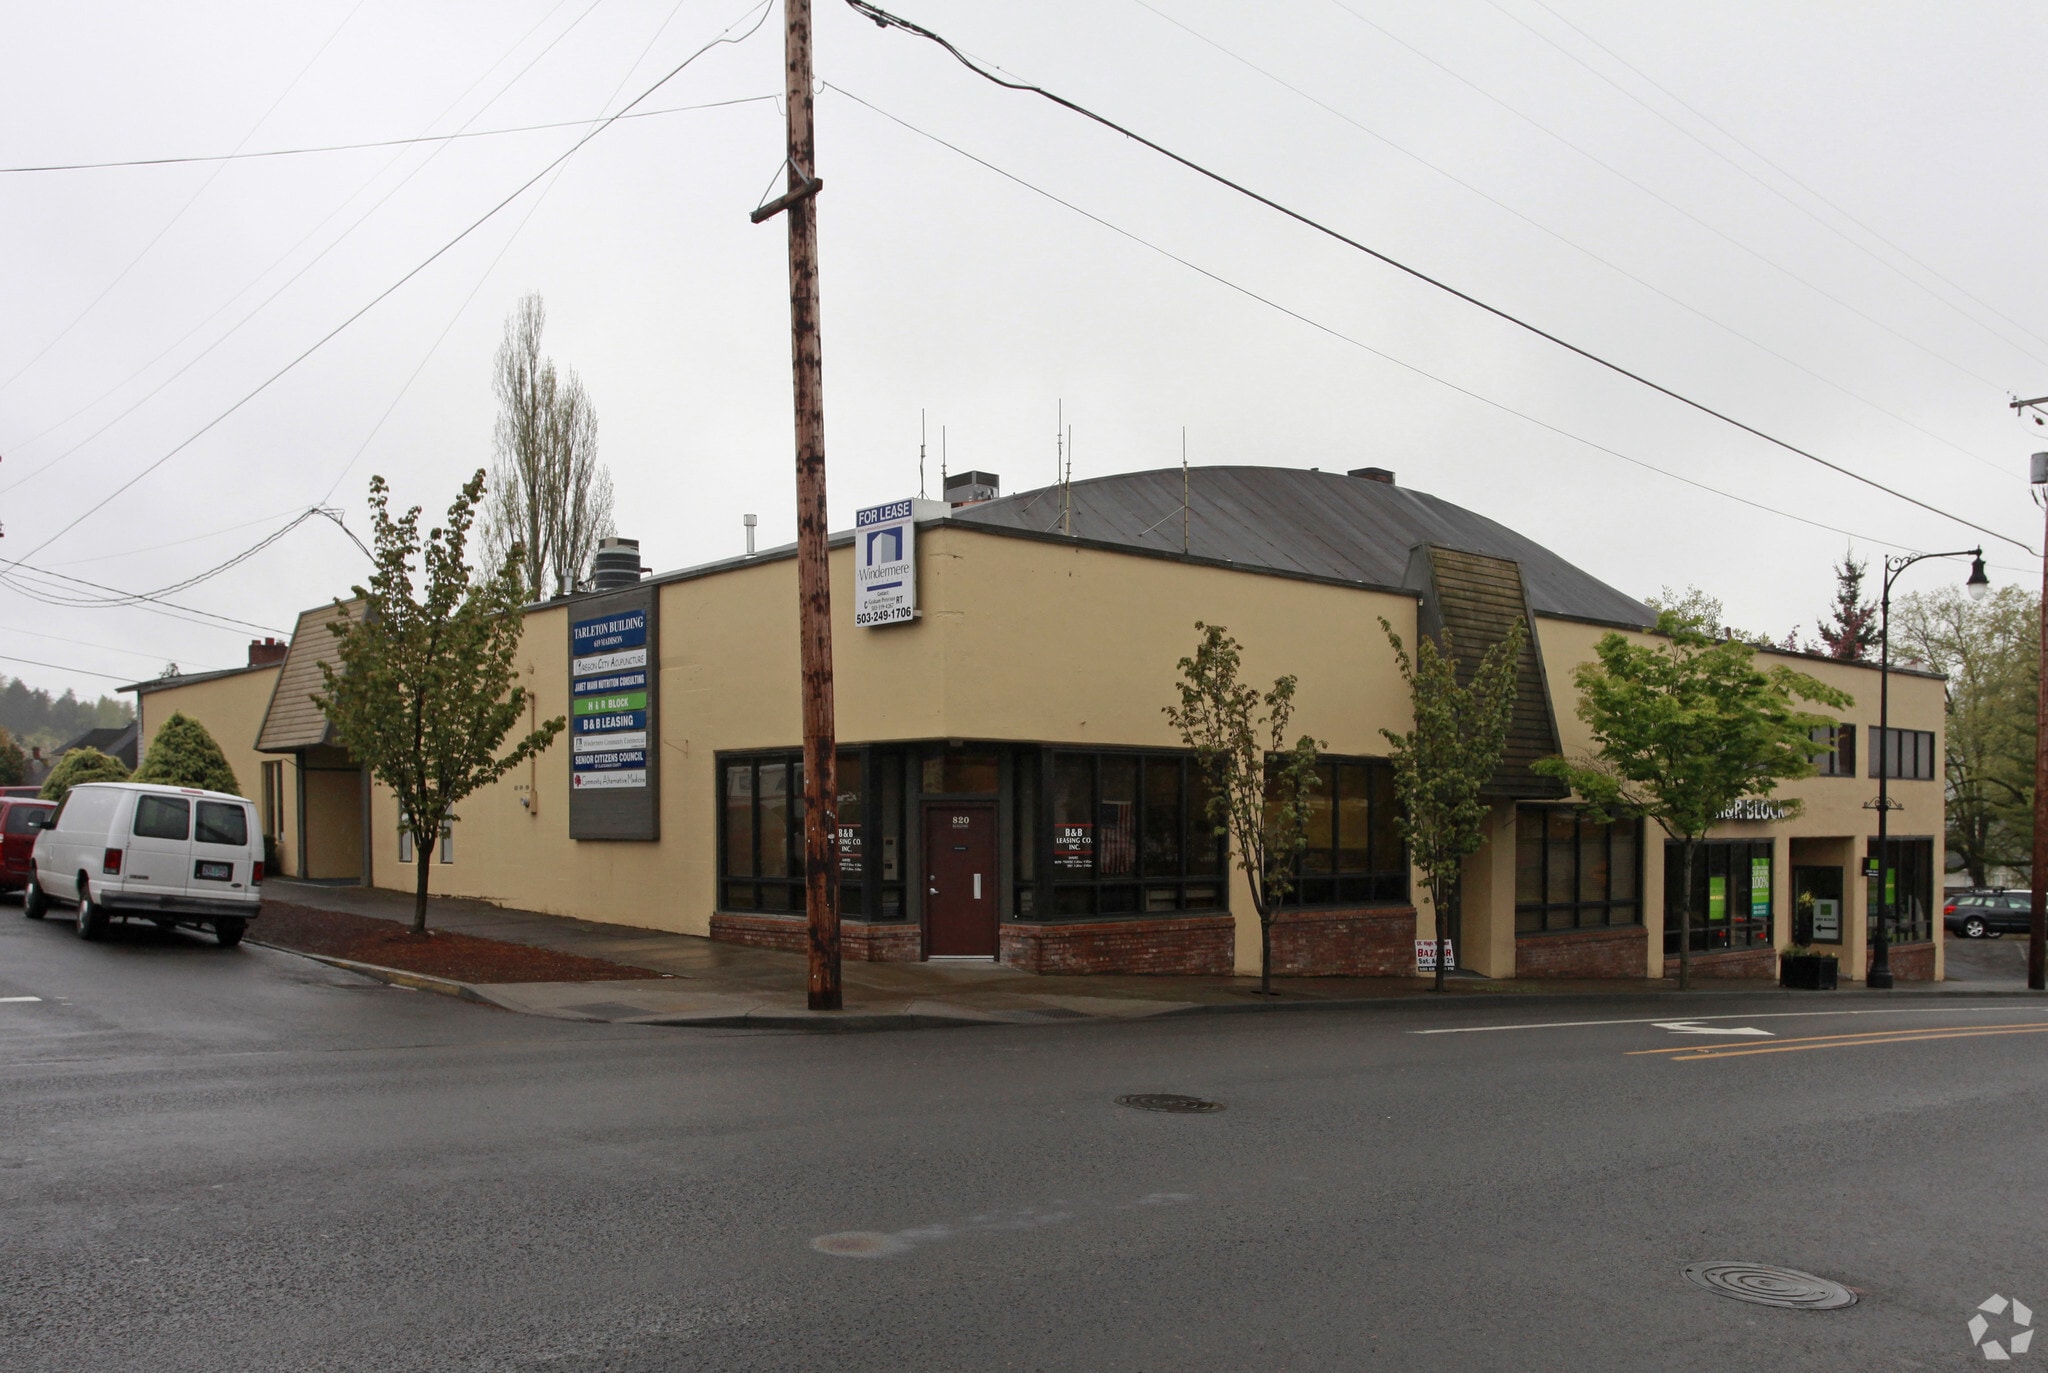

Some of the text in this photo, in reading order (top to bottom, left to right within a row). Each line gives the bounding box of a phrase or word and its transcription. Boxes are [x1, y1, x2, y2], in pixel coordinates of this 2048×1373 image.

[859, 510, 878, 526] FOR
[880, 502, 910, 520] LEASE
[859, 563, 910, 581] Windermere
[574, 615, 644, 640] TARLETON BUILDING
[601, 635, 623, 646] MADISON
[620, 674, 645, 687] CONSULTING
[588, 701, 593, 710] H
[601, 700, 606, 709] R
[608, 697, 629, 708] BLOCK
[602, 715, 634, 728] LEASING
[575, 751, 644, 765] SENIOR CITIZENS COUNCIL
[1746, 799, 1785, 819] BLOCK
[952, 816, 970, 824] 820
[838, 828, 854, 838] B&B
[1065, 828, 1083, 837] B&B
[1752, 876, 1769, 889] 100%
[1418, 949, 1451, 957] BAZR
